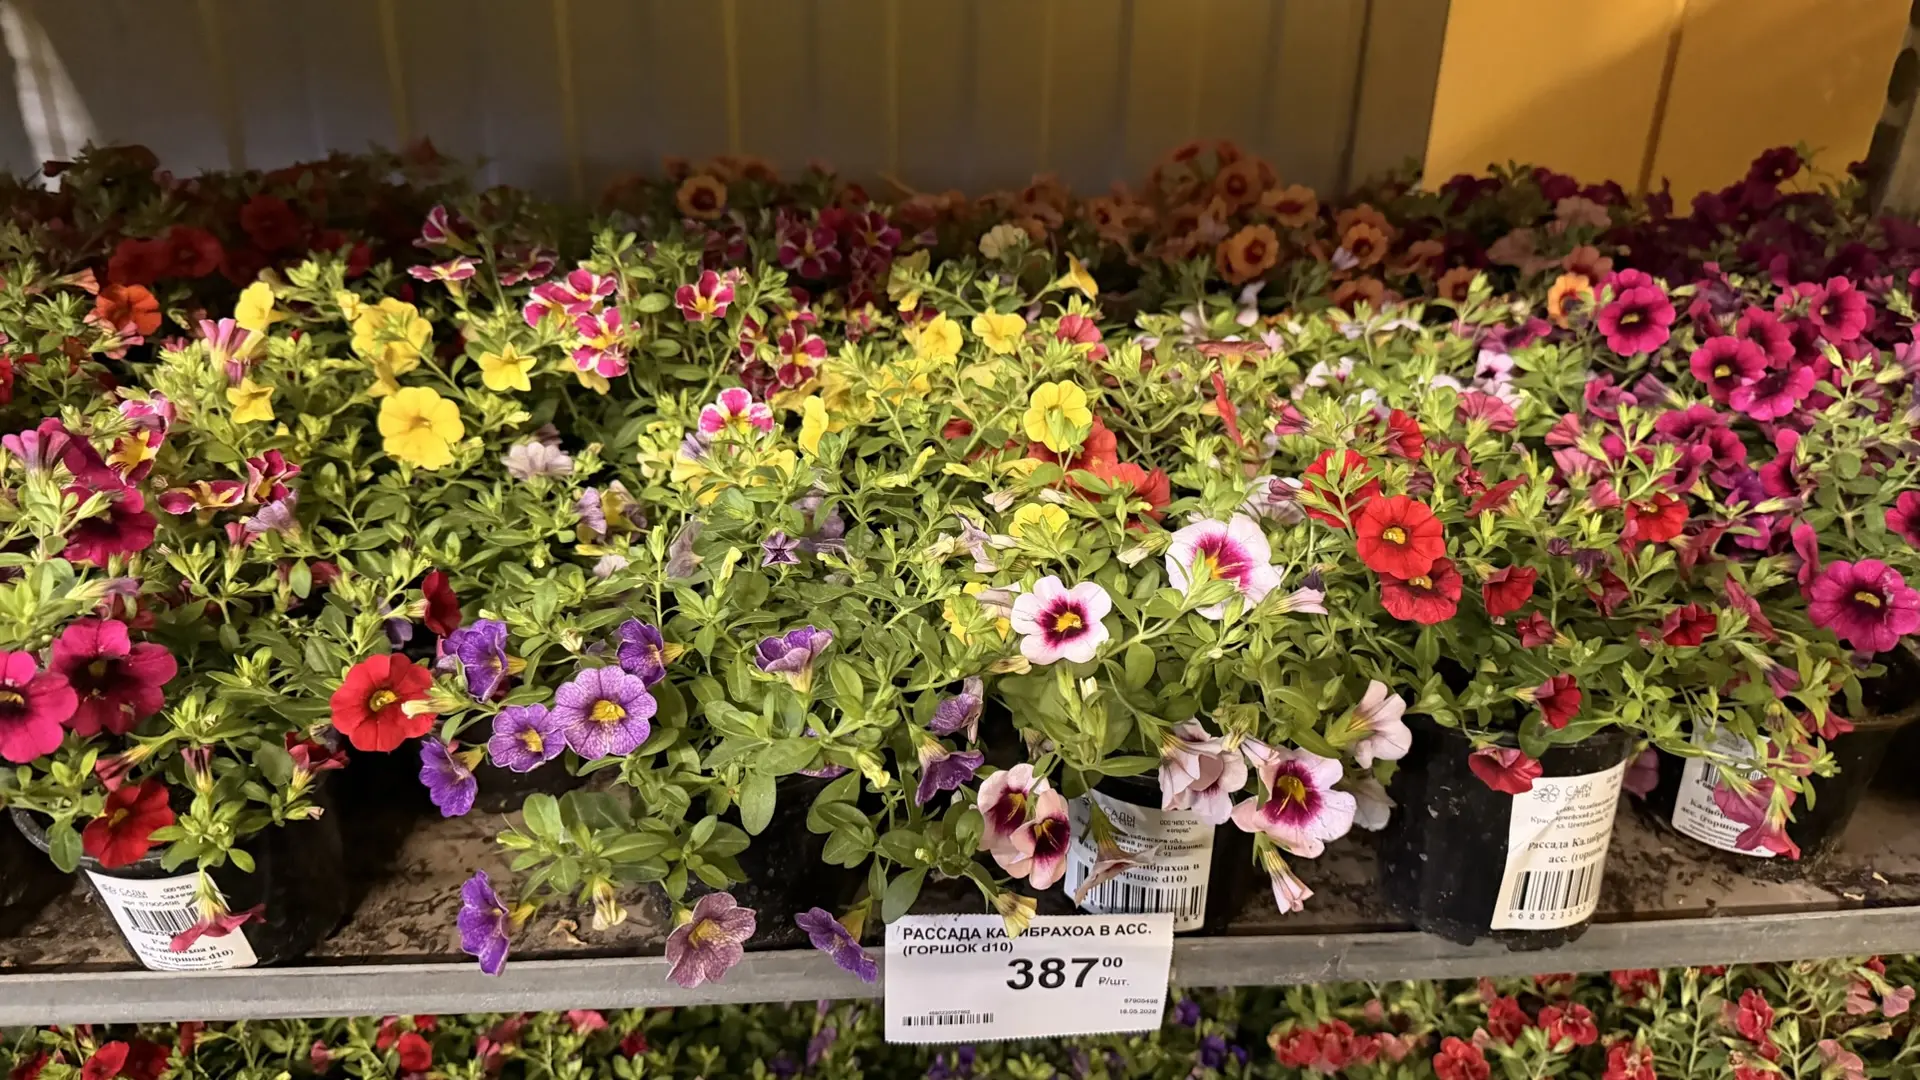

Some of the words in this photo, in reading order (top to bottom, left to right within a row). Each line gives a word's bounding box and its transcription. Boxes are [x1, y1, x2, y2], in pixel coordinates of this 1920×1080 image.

[1548, 855, 1568, 864] асс.
[1138, 862, 1189, 873] ибрахоа
[1119, 871, 1159, 883] оршок
[1161, 875, 1188, 884] d10)
[903, 927, 982, 941] РАССАДА
[986, 925, 1095, 939] КАИБРАХОА
[1100, 925, 1110, 936] В
[1115, 923, 1152, 935] АСС.
[208, 949, 235, 960] d10)
[903, 943, 977, 957] (ГОРШОК
[981, 941, 1013, 953] d10)
[1006, 957, 1099, 990] 387
[1102, 956, 1123, 968] 00
